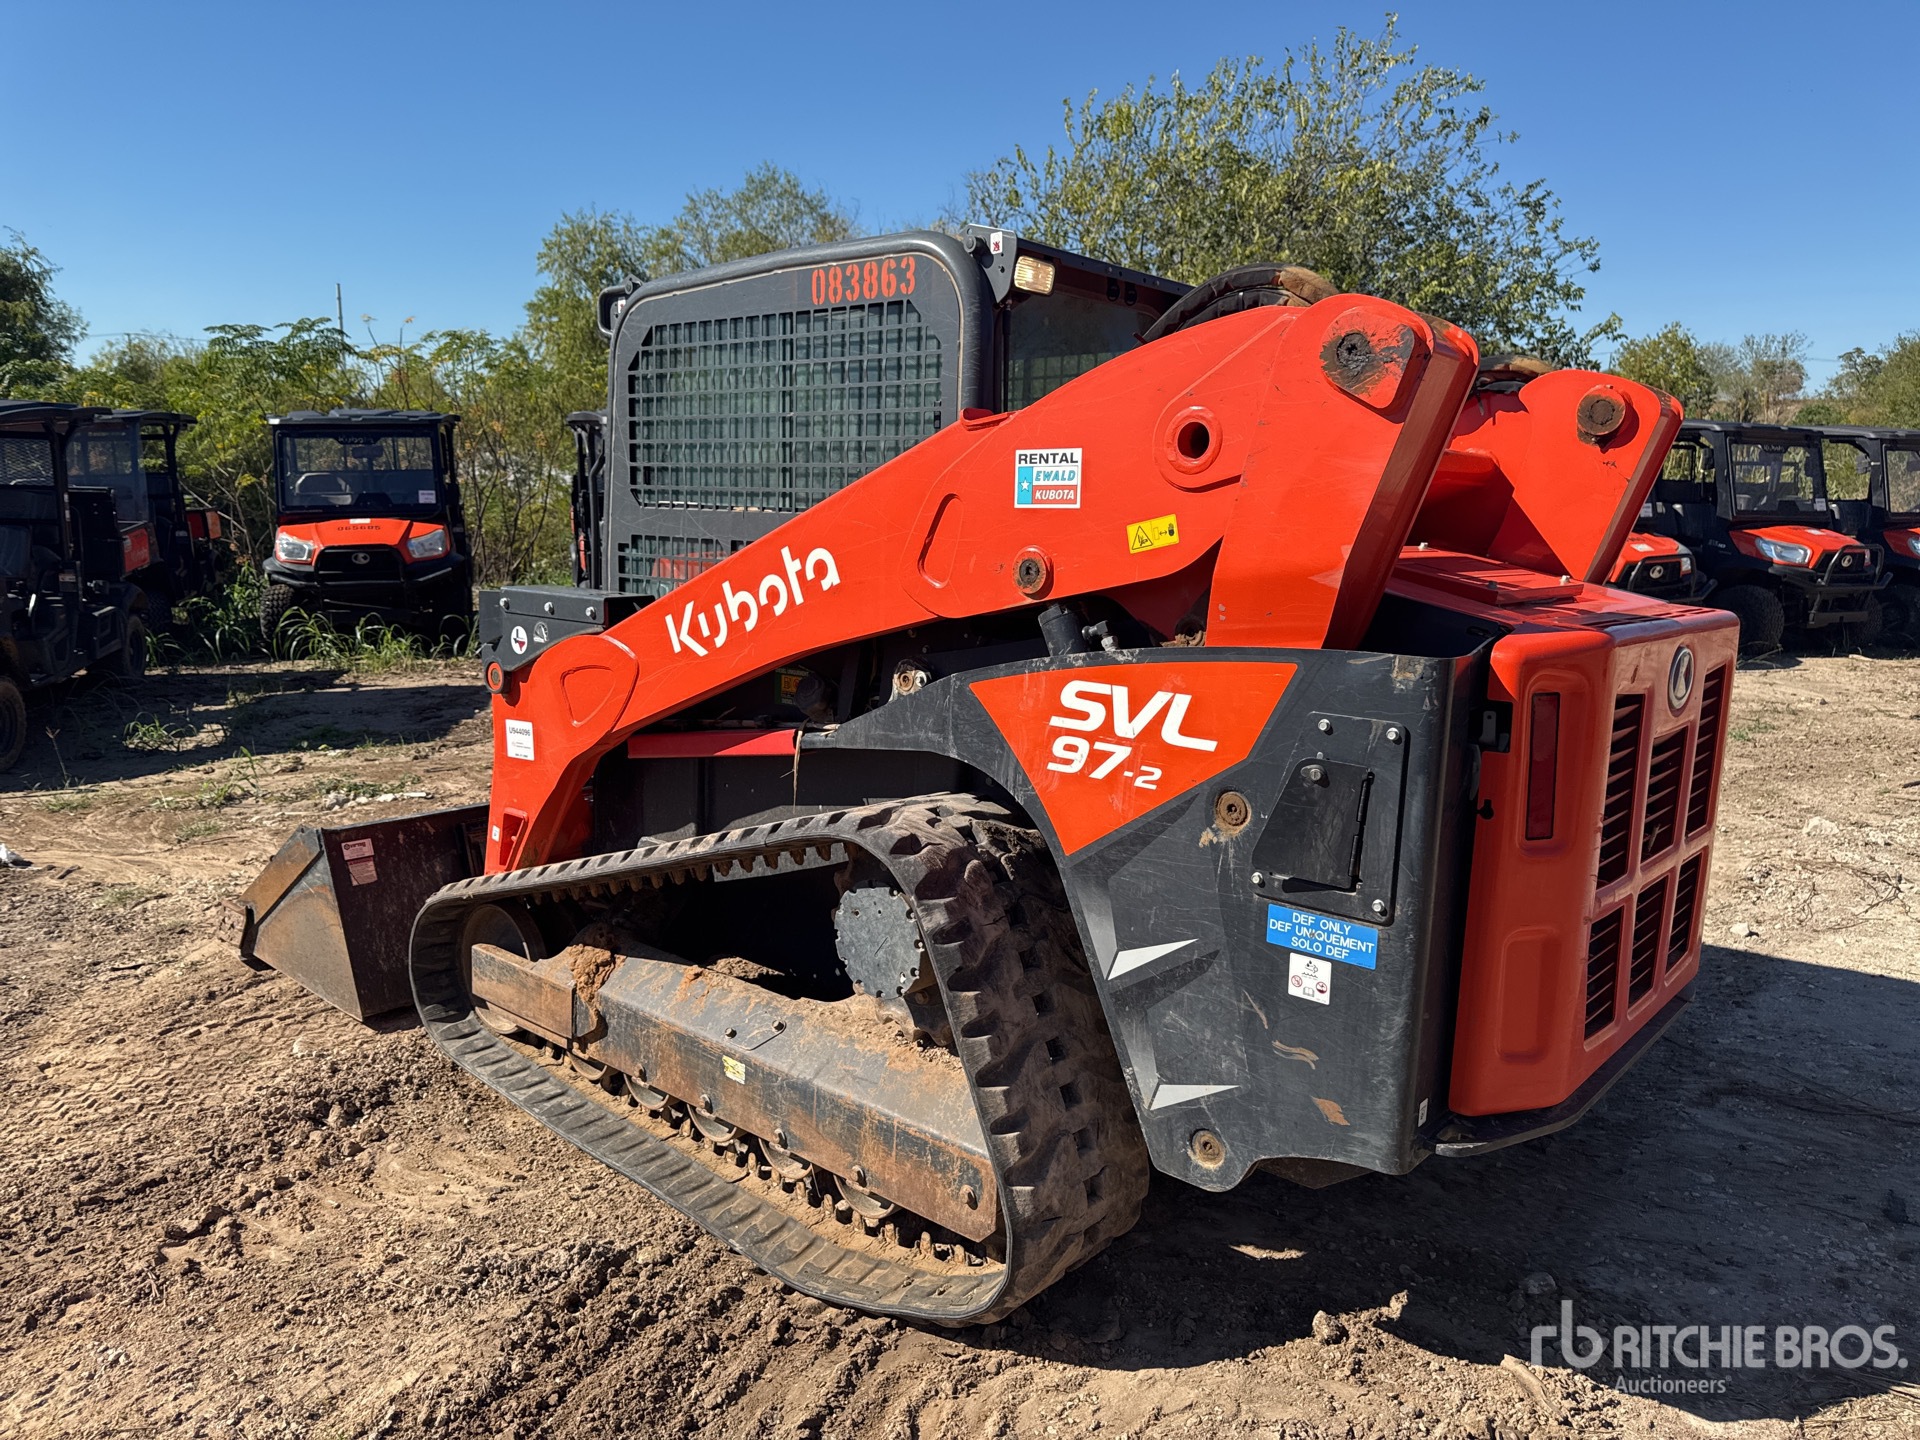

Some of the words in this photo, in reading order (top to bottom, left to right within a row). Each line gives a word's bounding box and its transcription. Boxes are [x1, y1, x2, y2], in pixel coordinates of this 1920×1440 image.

[811, 256, 916, 305] 083863
[1018, 452, 1079, 465] RENTAL
[1034, 470, 1076, 482] EWALD
[1034, 489, 1075, 500] KUBOTA
[664, 545, 841, 657] Kubota
[1048, 679, 1219, 753] SVL
[1046, 735, 1163, 791] 97-2
[1269, 919, 1292, 933] DEF
[1293, 912, 1315, 926] DEF
[1320, 920, 1351, 935] ONLY
[1291, 937, 1322, 952] SOLO
[1326, 945, 1349, 959] DEF
